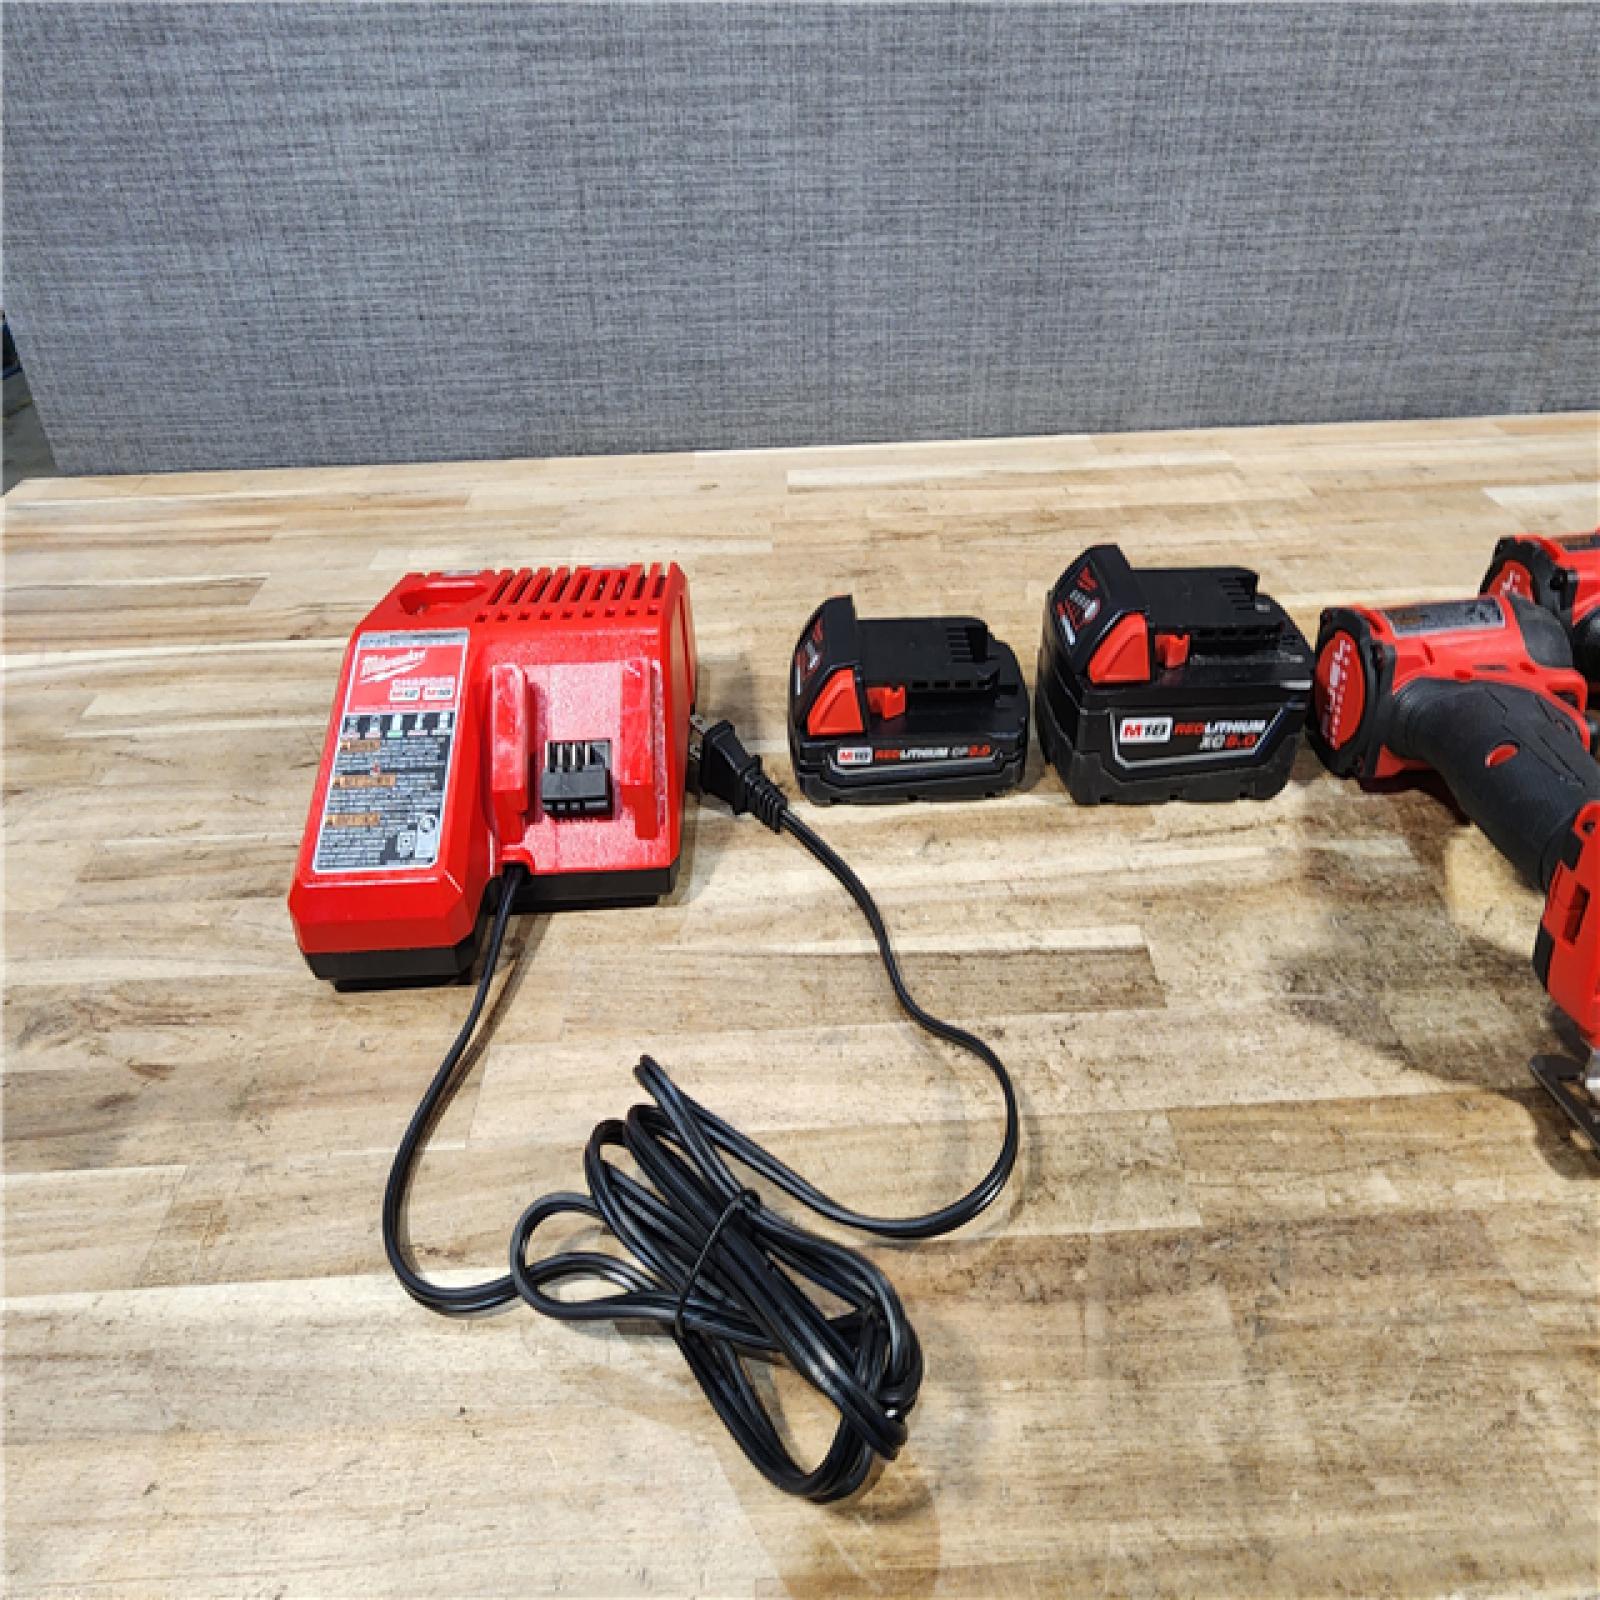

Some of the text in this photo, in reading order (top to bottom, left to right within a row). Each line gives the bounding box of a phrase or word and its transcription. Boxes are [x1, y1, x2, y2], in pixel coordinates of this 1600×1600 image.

[1123, 719, 1266, 737] M18 REDLITHIUM
[839, 750, 870, 761] M18
